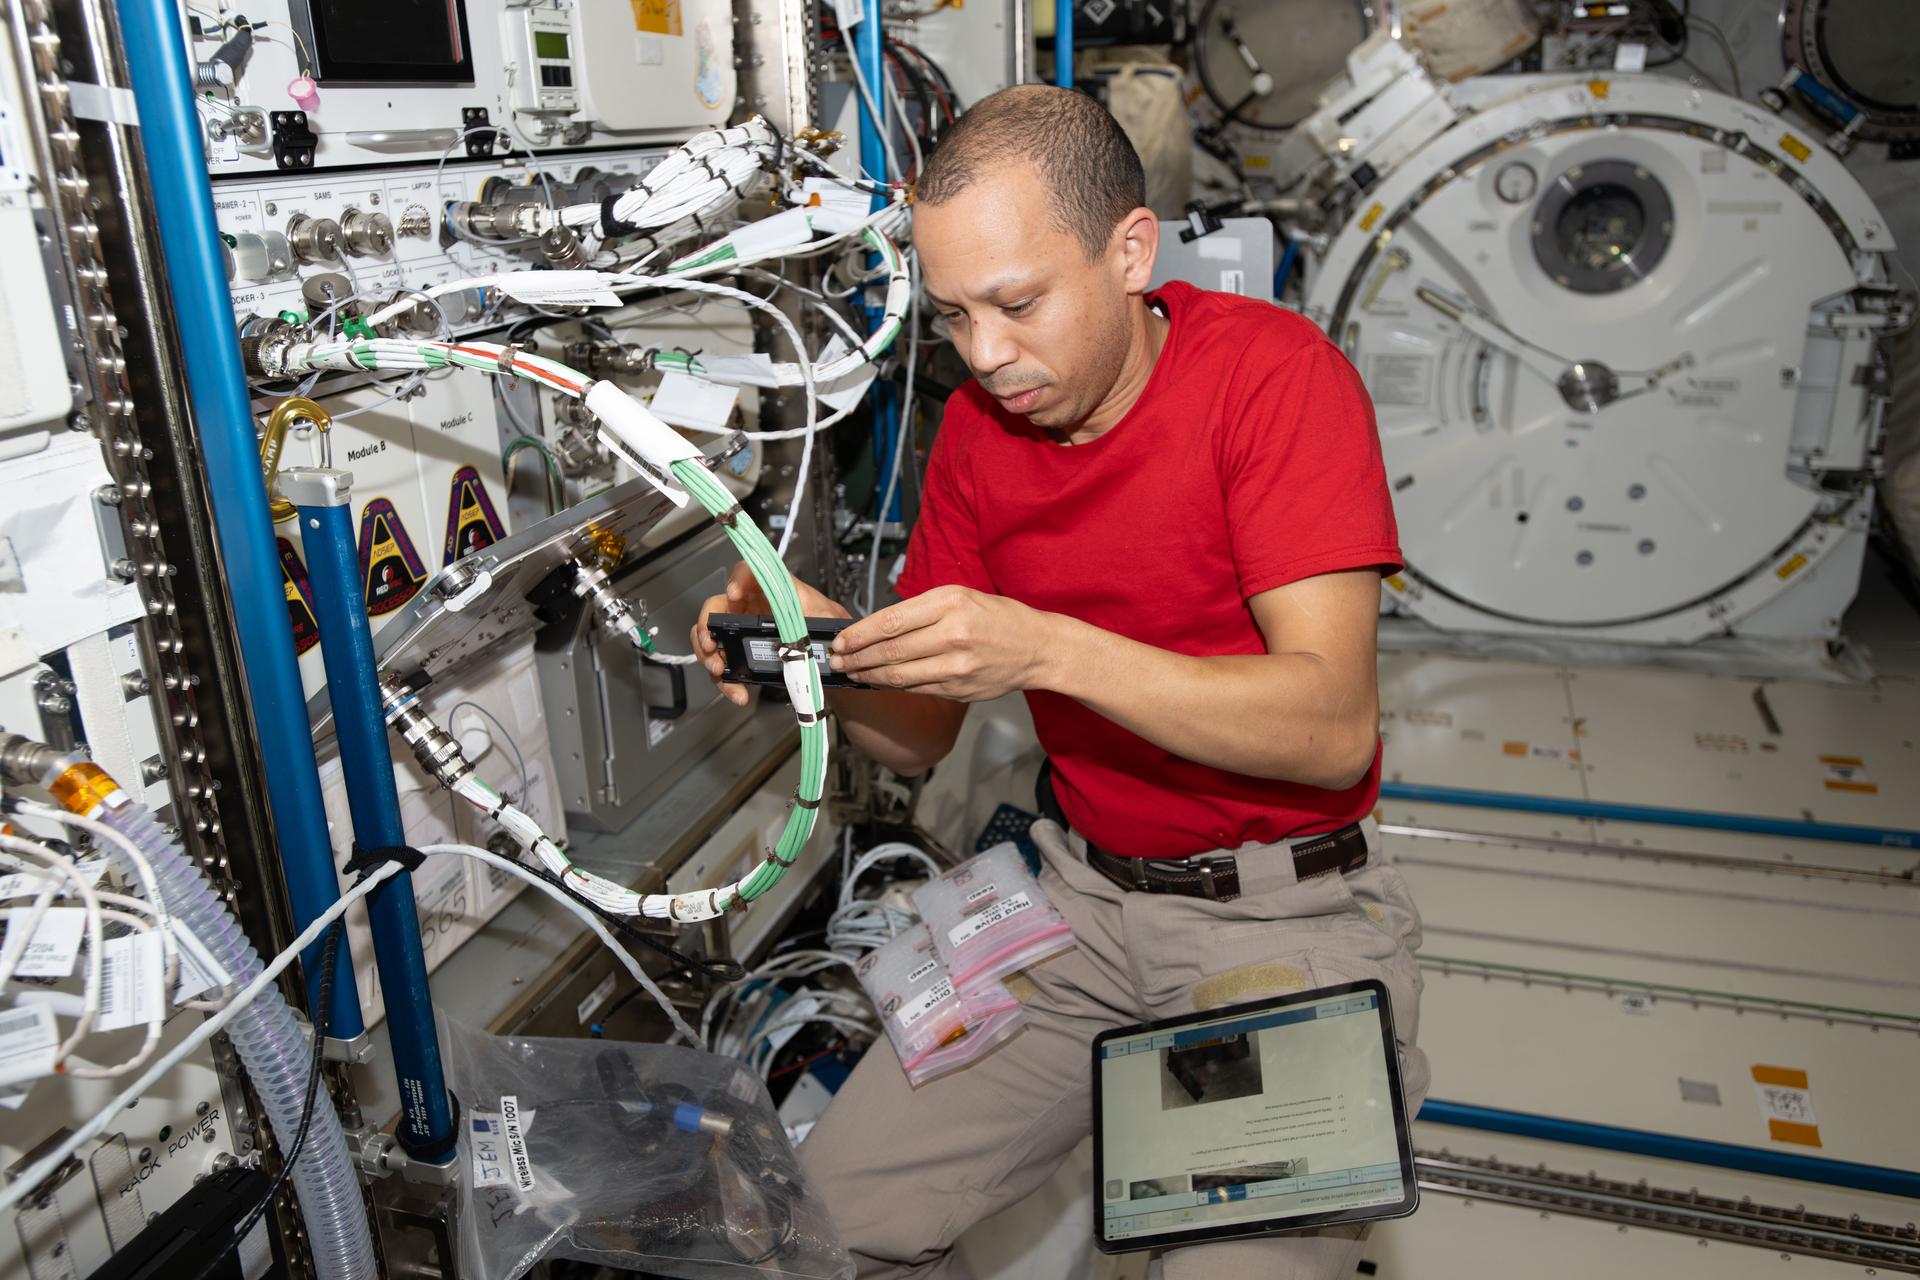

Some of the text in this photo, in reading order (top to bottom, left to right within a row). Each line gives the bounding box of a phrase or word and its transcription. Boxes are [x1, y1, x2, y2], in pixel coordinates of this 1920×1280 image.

[314, 192, 332, 200] SAMS
[231, 294, 255, 305] OCKER
[440, 412, 473, 431] Module C
[347, 440, 387, 462] Module B
[968, 885, 995, 901] Keep
[1004, 900, 1030, 916] Hard
[973, 913, 1002, 931] Drive
[909, 962, 935, 981] Keep
[924, 988, 951, 1010] Drive
[167, 1108, 221, 1158] POWER
[504, 1100, 532, 1188] Wireless Mic S/N 1007
[478, 1141, 501, 1179] JEM
